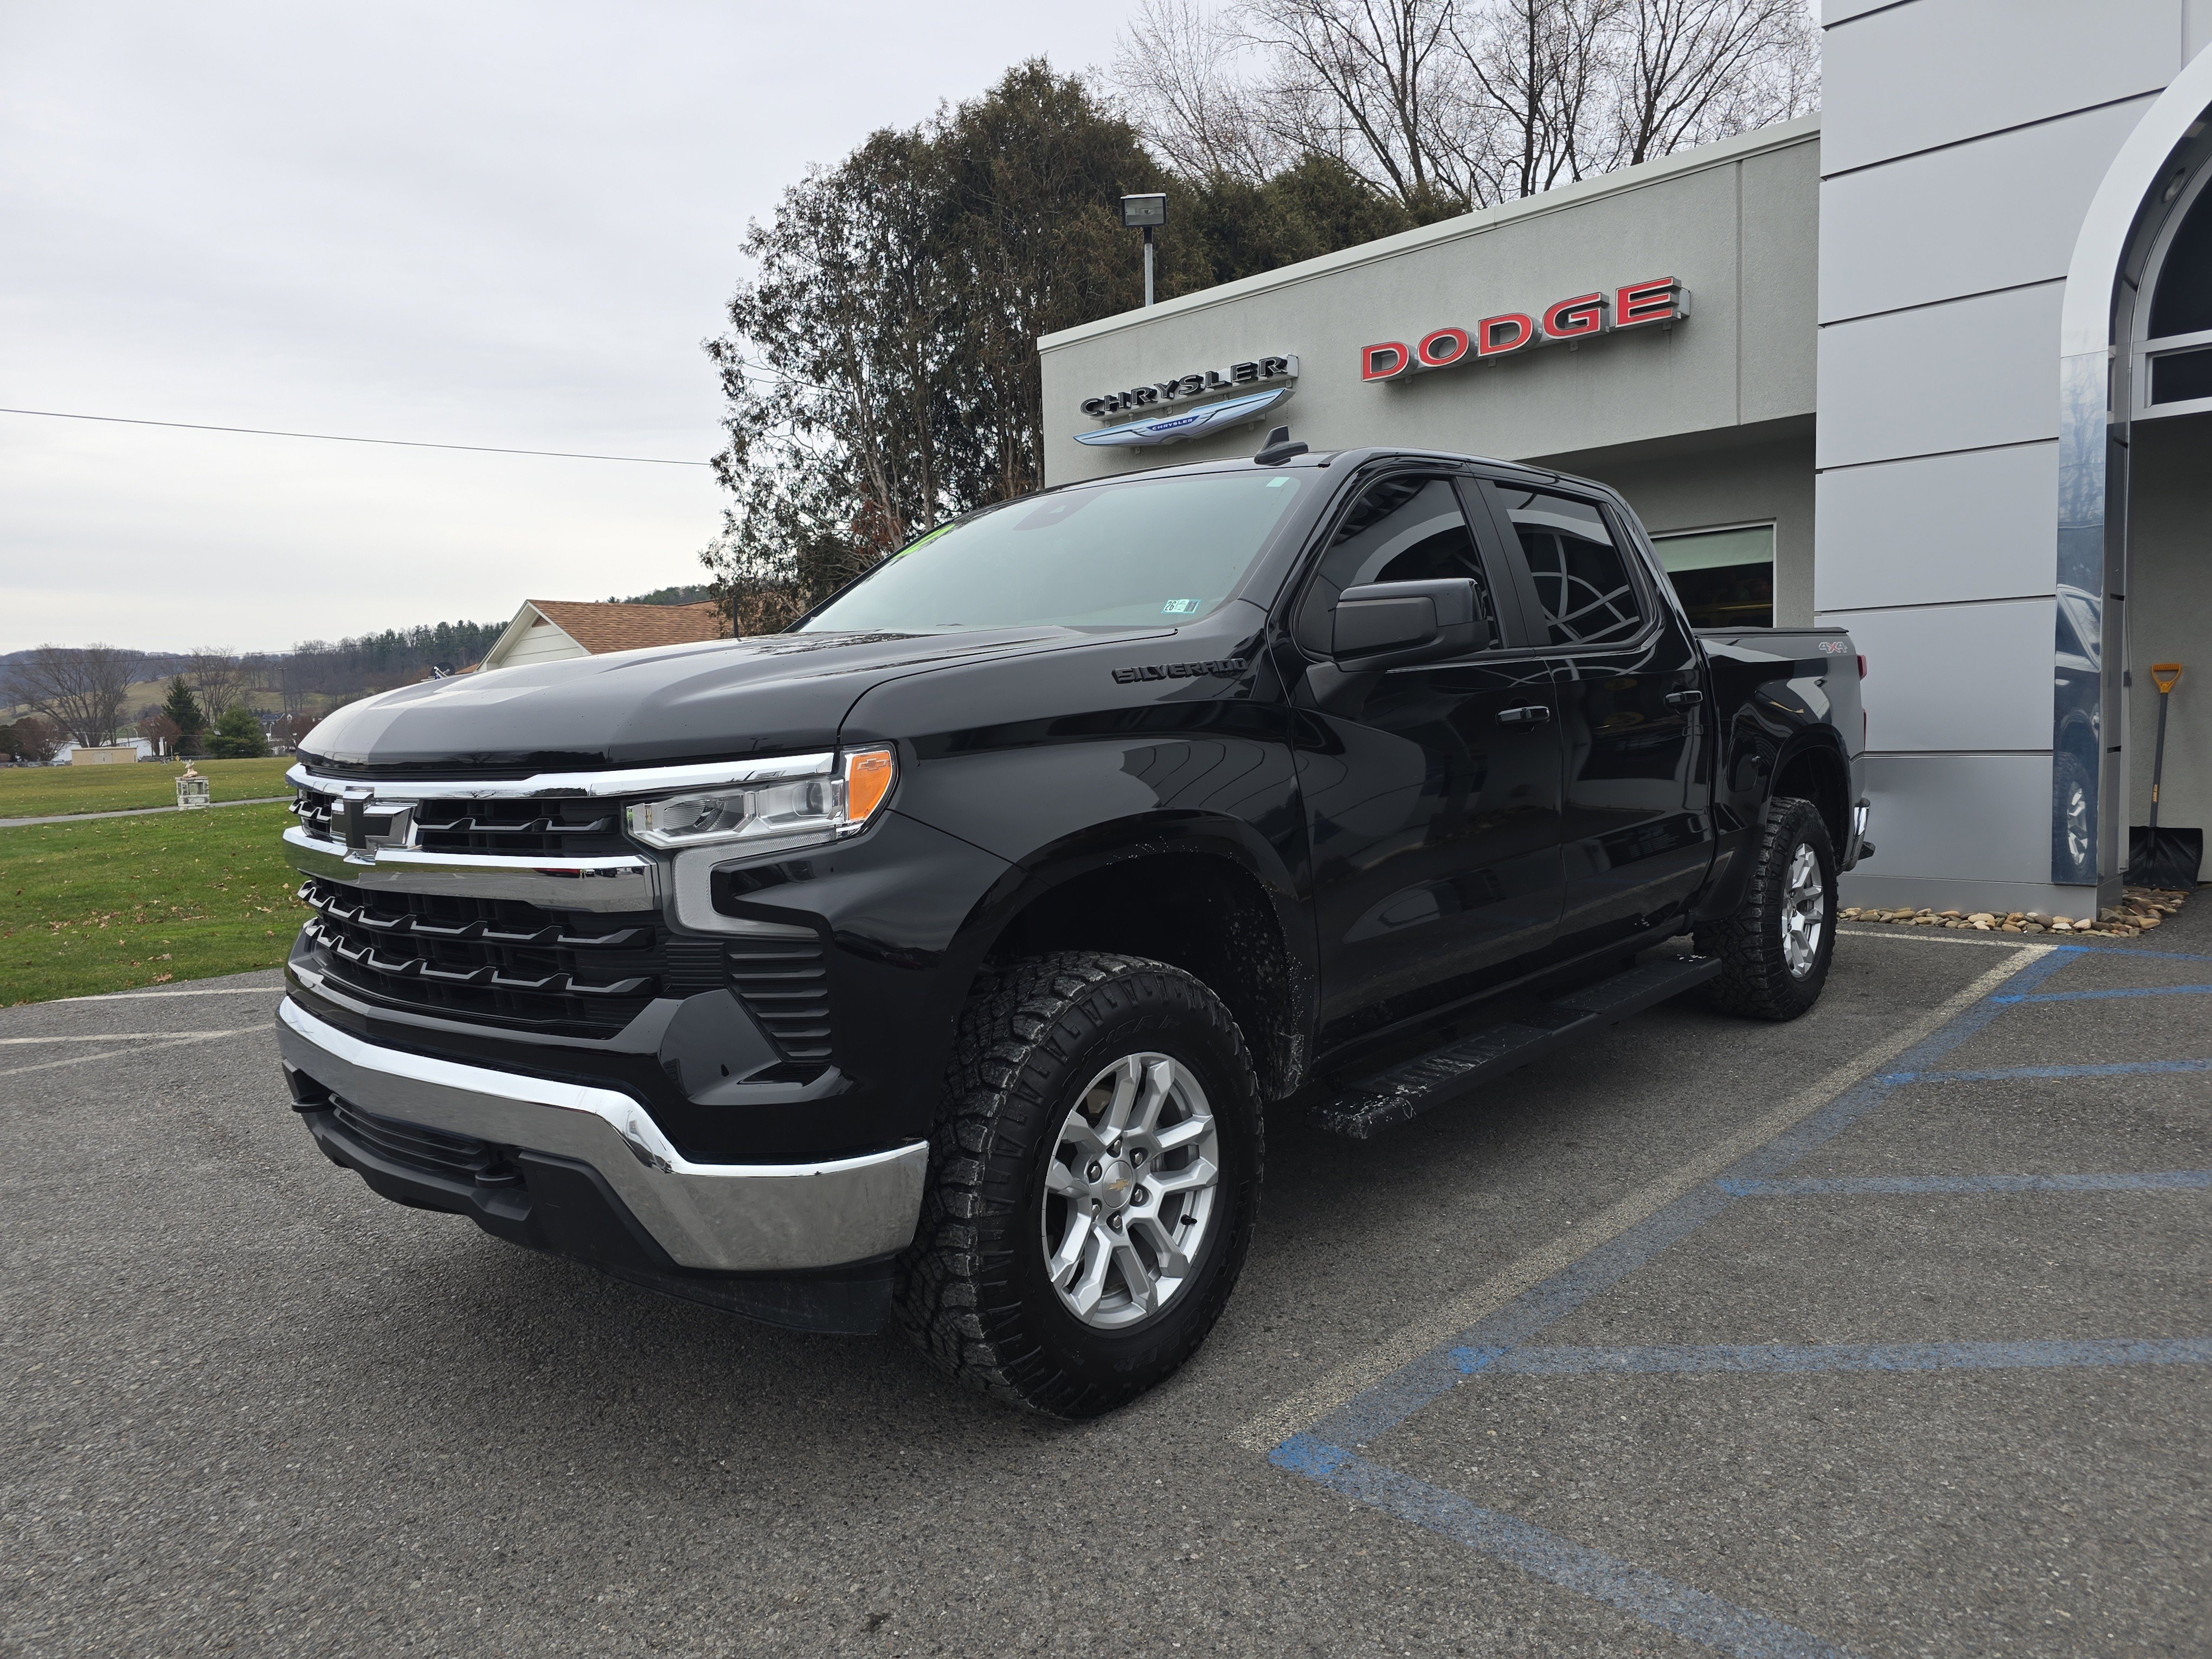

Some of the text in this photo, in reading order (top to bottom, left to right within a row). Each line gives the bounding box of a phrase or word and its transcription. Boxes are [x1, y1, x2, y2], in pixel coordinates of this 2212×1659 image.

[1360, 276, 1676, 383] DODGE
[1080, 356, 1288, 416] CHRYSLER
[1152, 419, 1193, 430] CHRYSLER
[1165, 601, 1177, 611] 26
[1111, 658, 1248, 684] SILVERADO
